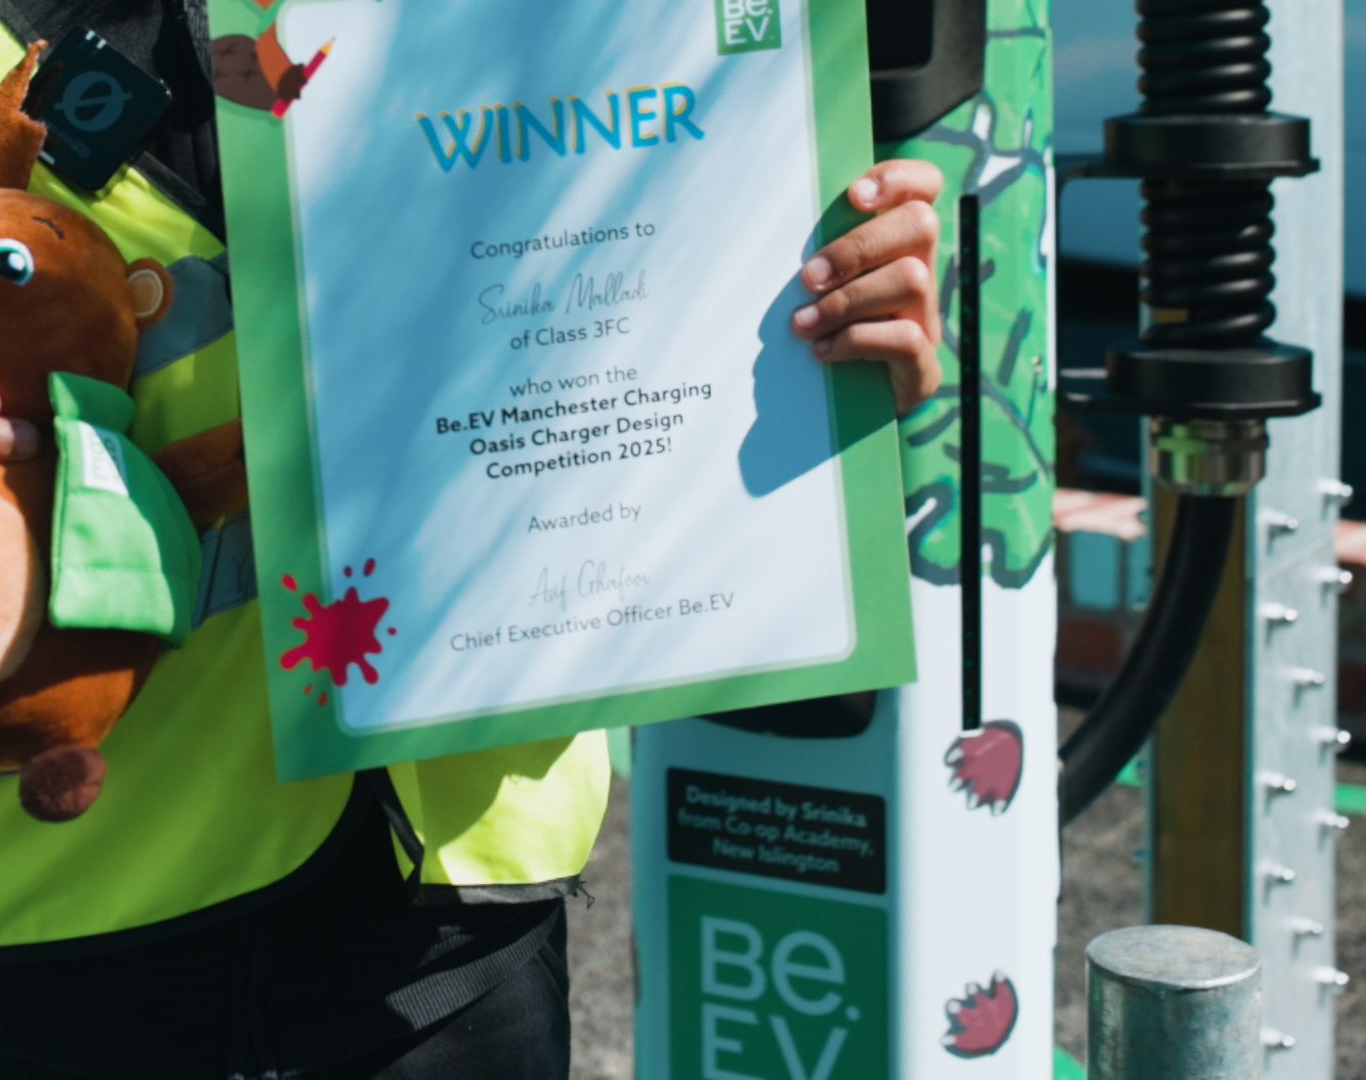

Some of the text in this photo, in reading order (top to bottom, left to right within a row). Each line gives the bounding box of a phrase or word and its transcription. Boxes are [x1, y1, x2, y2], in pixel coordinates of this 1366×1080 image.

[415, 82, 705, 173] WINNER
[469, 223, 655, 260] Congratulations to
[510, 317, 630, 350] of Class 3FC
[509, 365, 638, 398] who won the
[436, 382, 712, 435] Be.EV Manchester Charging
[469, 412, 684, 456] Oasis Charger Design
[486, 436, 672, 480] Competition 2025!
[527, 501, 642, 534] Awarded by
[450, 591, 735, 652] Chief Executive Officer Be.EV
[677, 807, 722, 831] from
[685, 784, 868, 828] Designed by Srinika
[712, 837, 840, 873] New Islington
